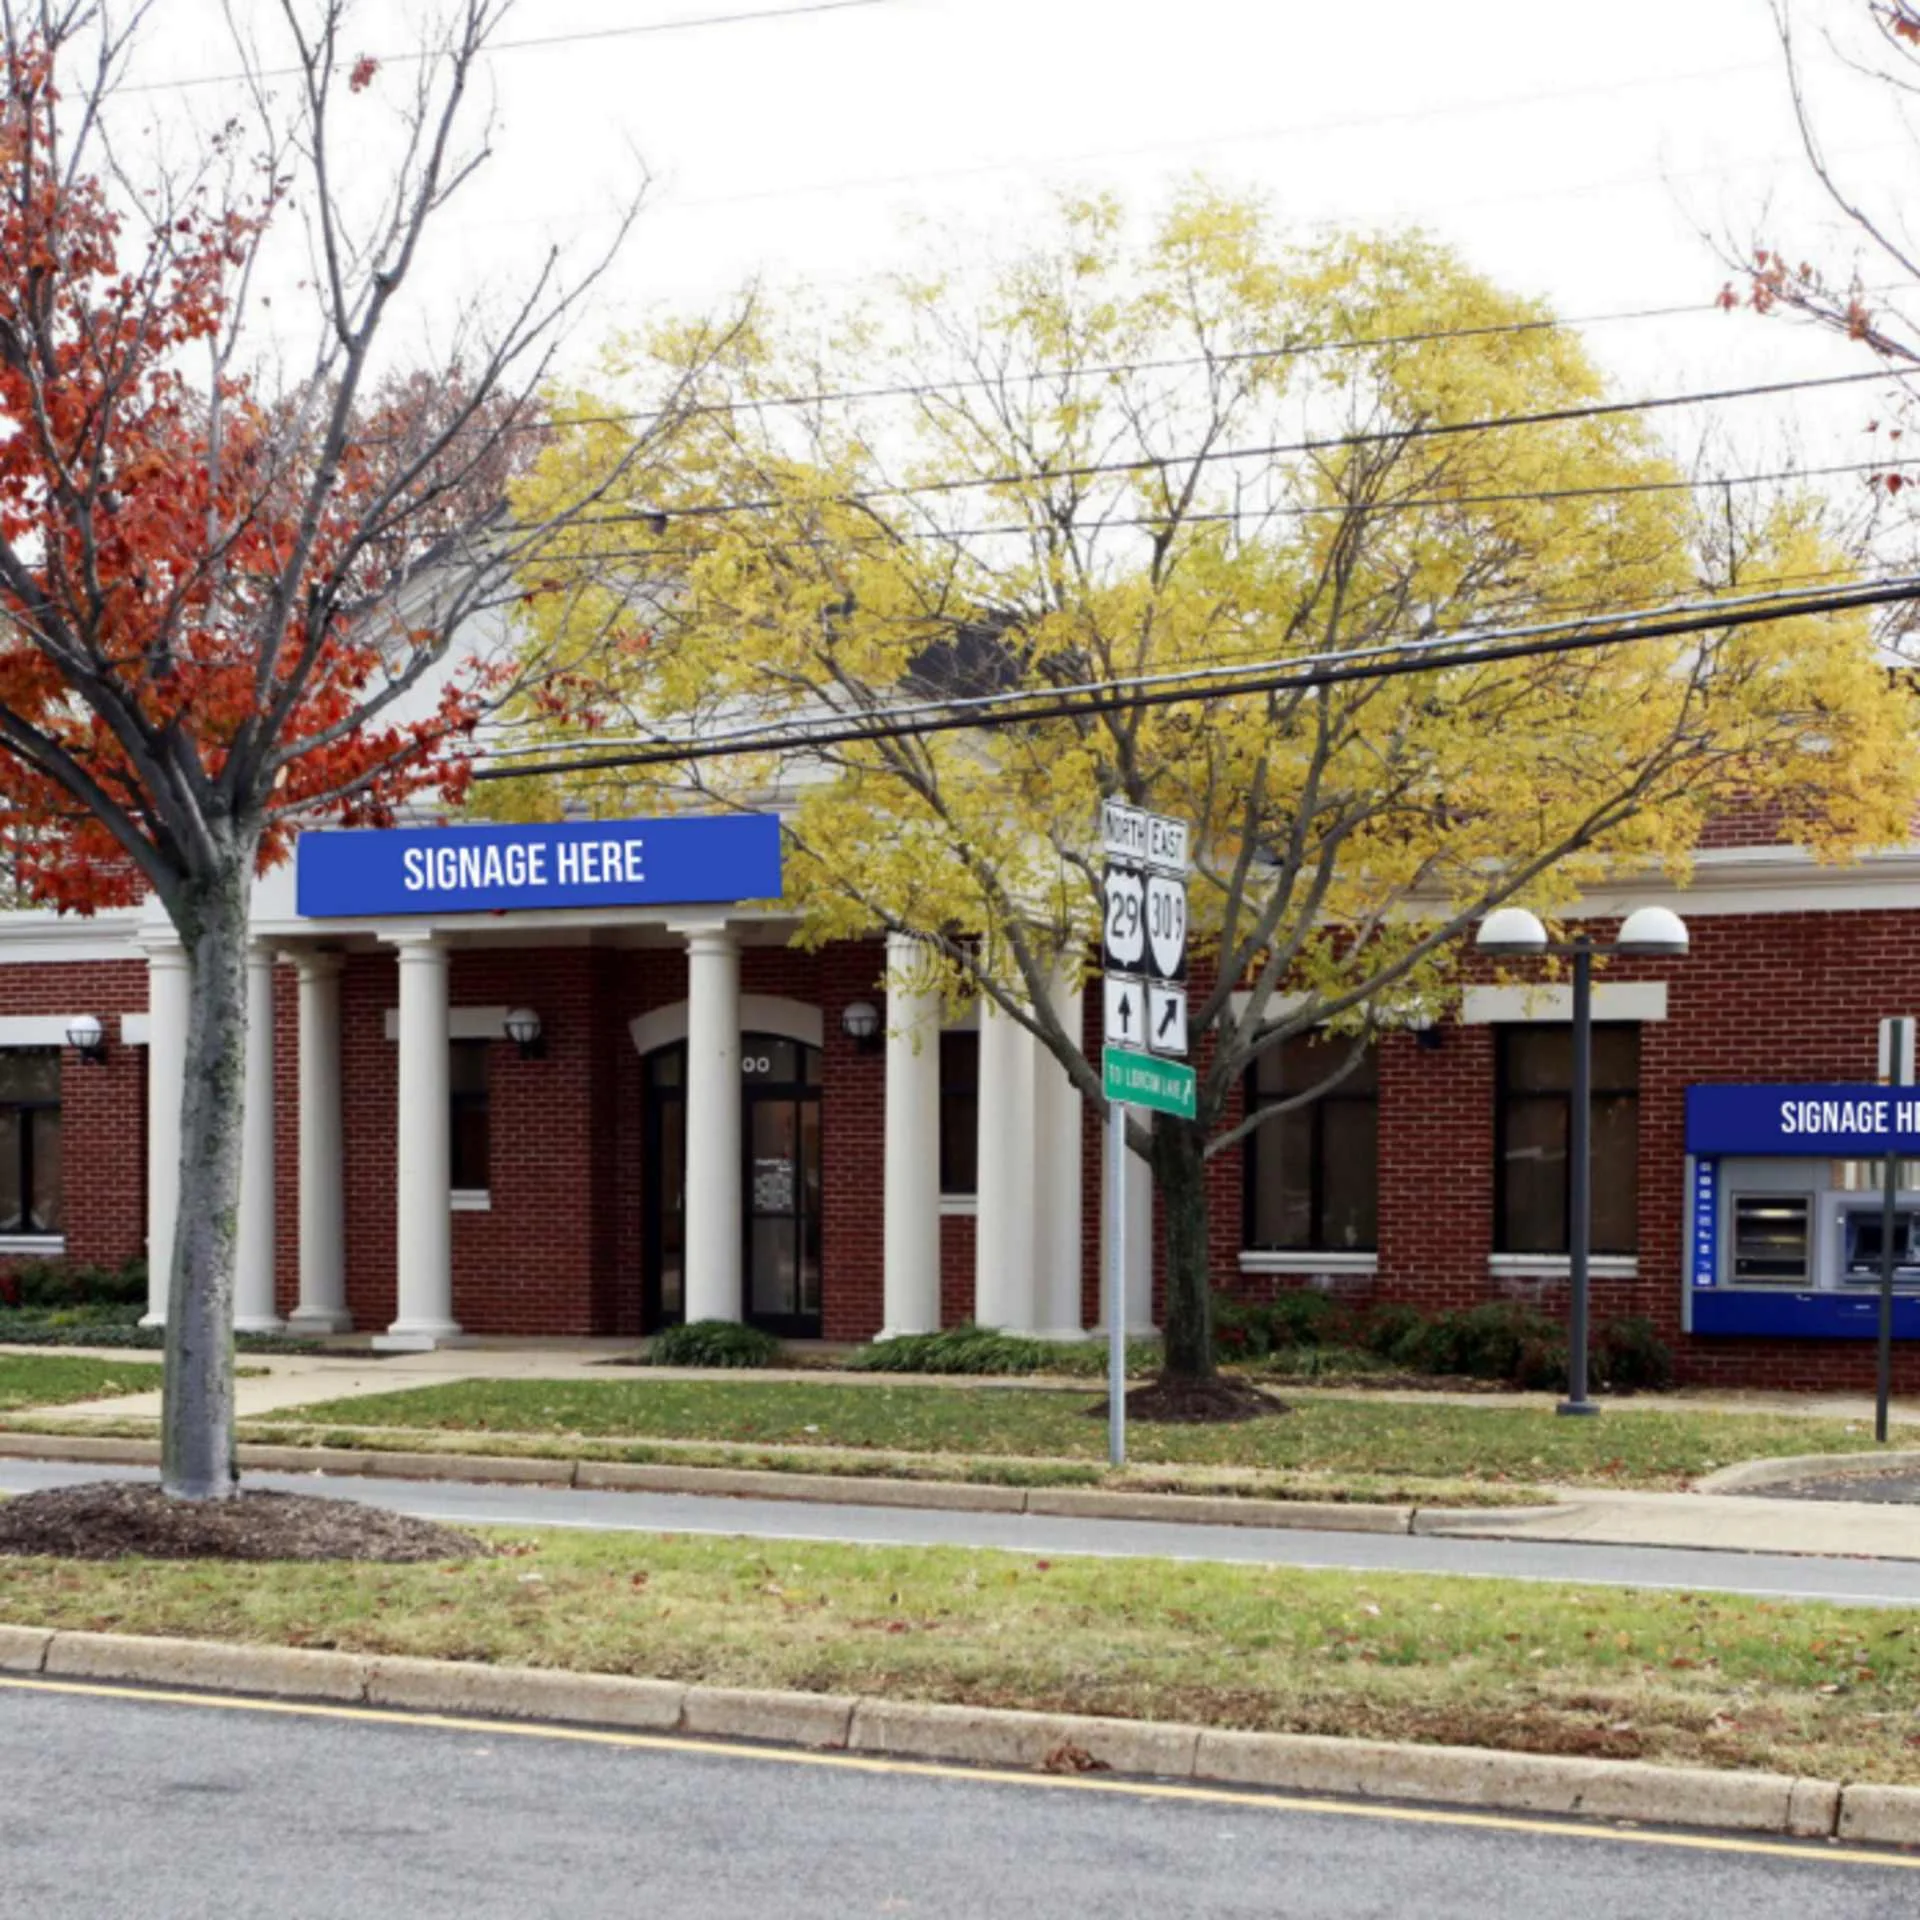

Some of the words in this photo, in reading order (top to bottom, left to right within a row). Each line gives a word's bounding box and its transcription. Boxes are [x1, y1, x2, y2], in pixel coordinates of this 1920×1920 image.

[1105, 809, 1145, 847] NORTH
[1151, 821, 1183, 860] EAST
[403, 843, 548, 890] SIGNAGE
[557, 839, 645, 885] HERE
[1111, 890, 1139, 939] 29
[1151, 891, 1182, 941] 309
[1780, 1100, 1889, 1134] SIGNAGE
